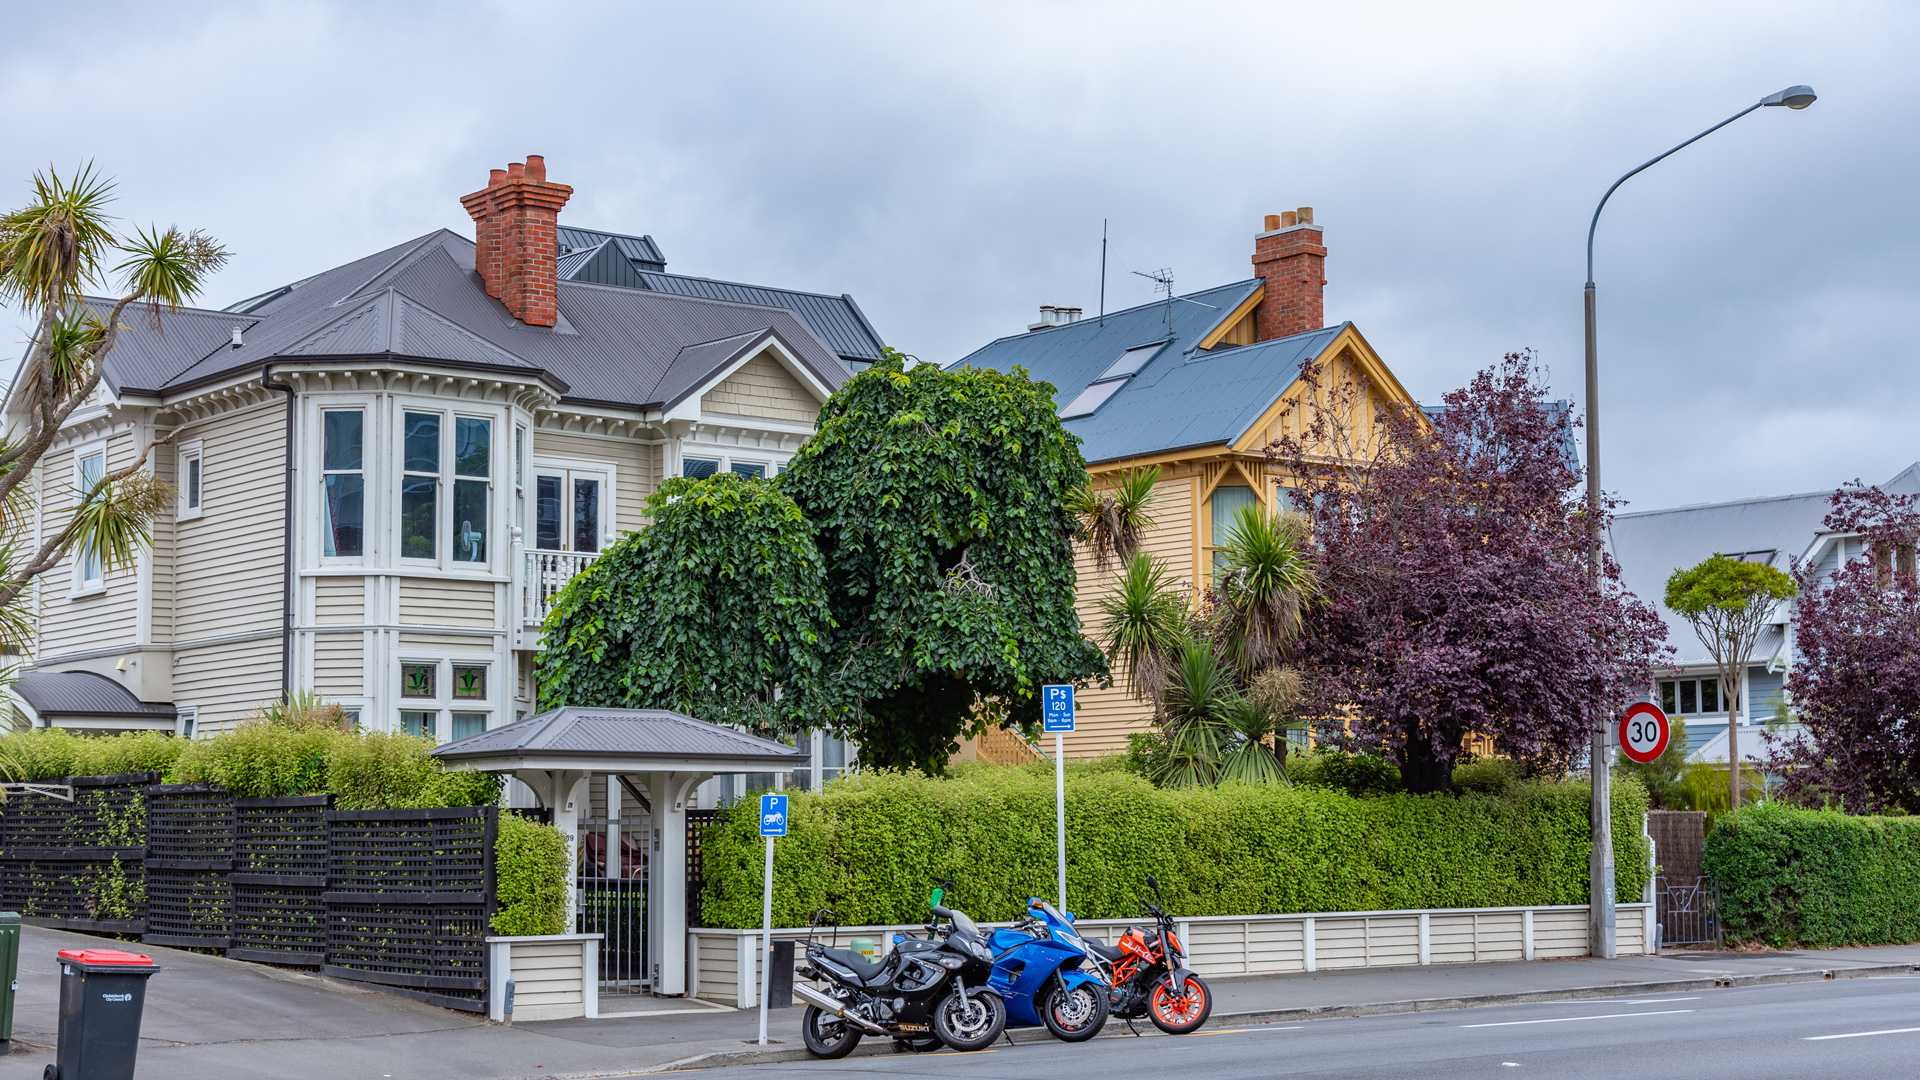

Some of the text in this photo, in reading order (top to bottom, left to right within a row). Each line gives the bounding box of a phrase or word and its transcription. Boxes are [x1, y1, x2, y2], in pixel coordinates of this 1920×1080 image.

[1051, 701, 1066, 710] 120
[1631, 721, 1657, 743] 30
[770, 797, 778, 810] P
[1121, 937, 1155, 964] DUKE
[899, 1024, 930, 1032] SUZUKI
